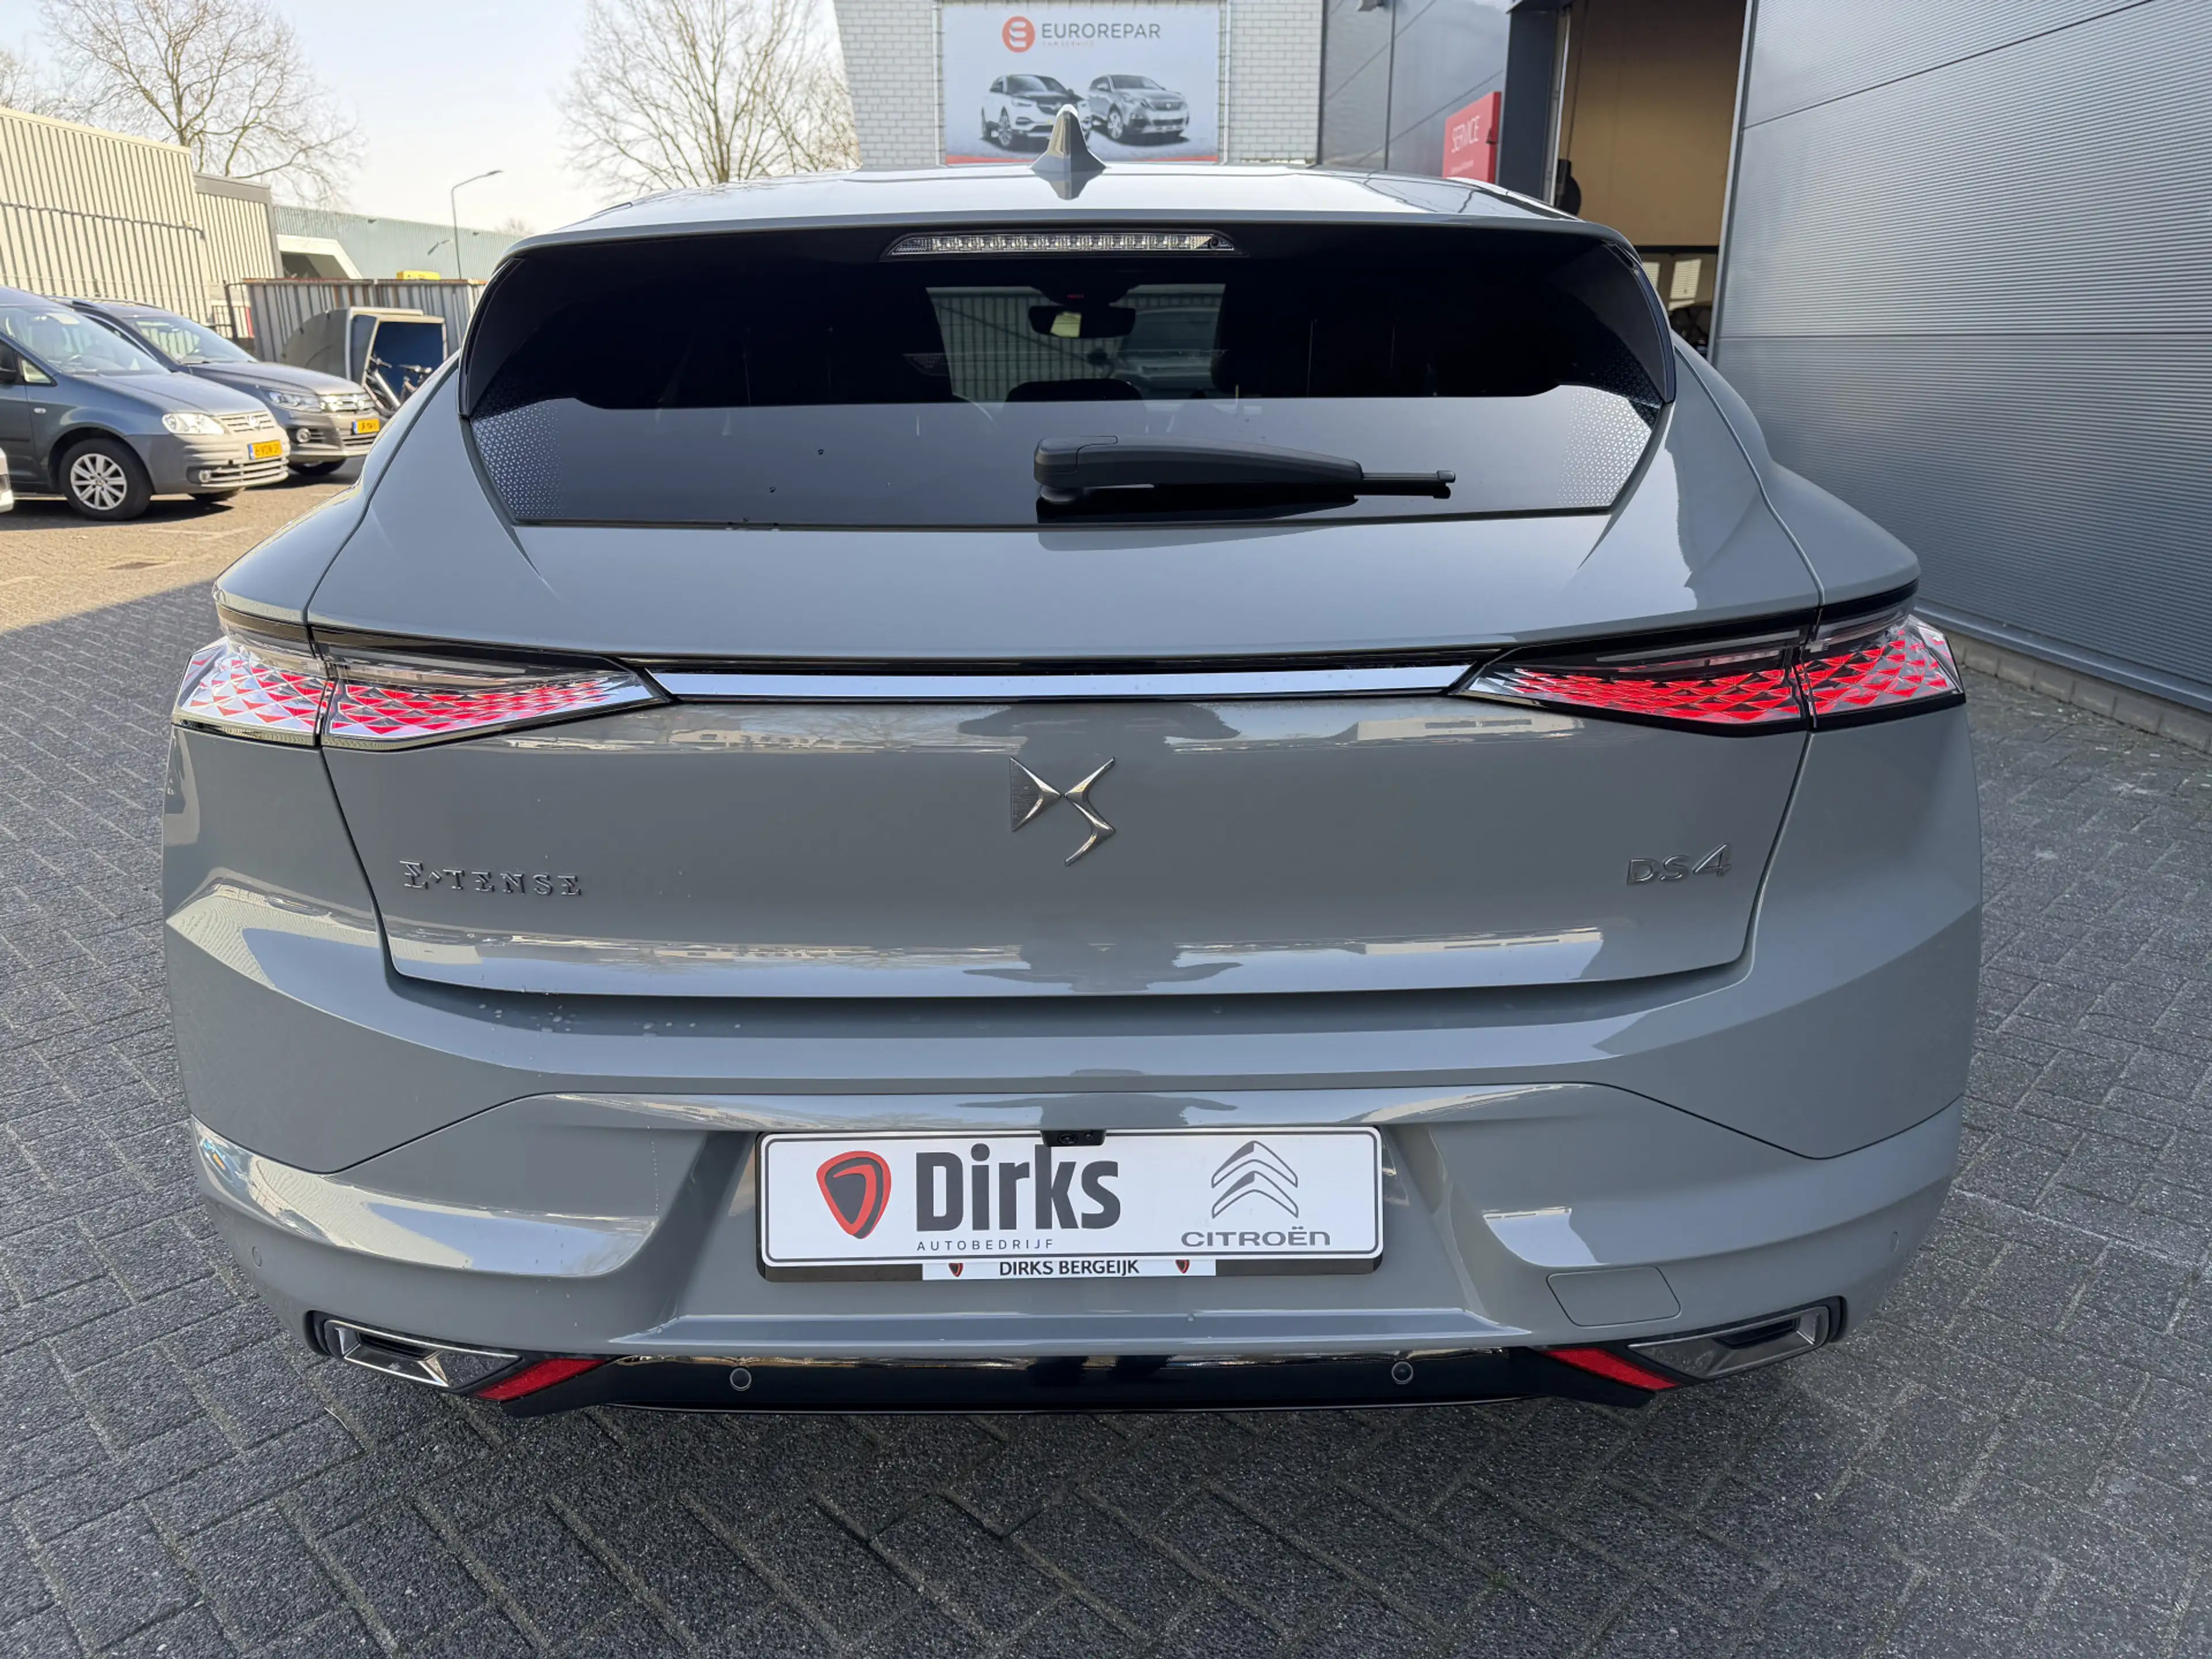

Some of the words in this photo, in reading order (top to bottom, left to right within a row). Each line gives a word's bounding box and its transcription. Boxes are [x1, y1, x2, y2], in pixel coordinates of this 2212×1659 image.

[1041, 23, 1161, 39] EUROREPAR
[916, 1143, 1120, 1232] Dirks
[916, 1238, 1053, 1251] AUTOBEDRIJF
[999, 1261, 1054, 1276] DIRKS
[1059, 1260, 1140, 1276] BERGEIJK
